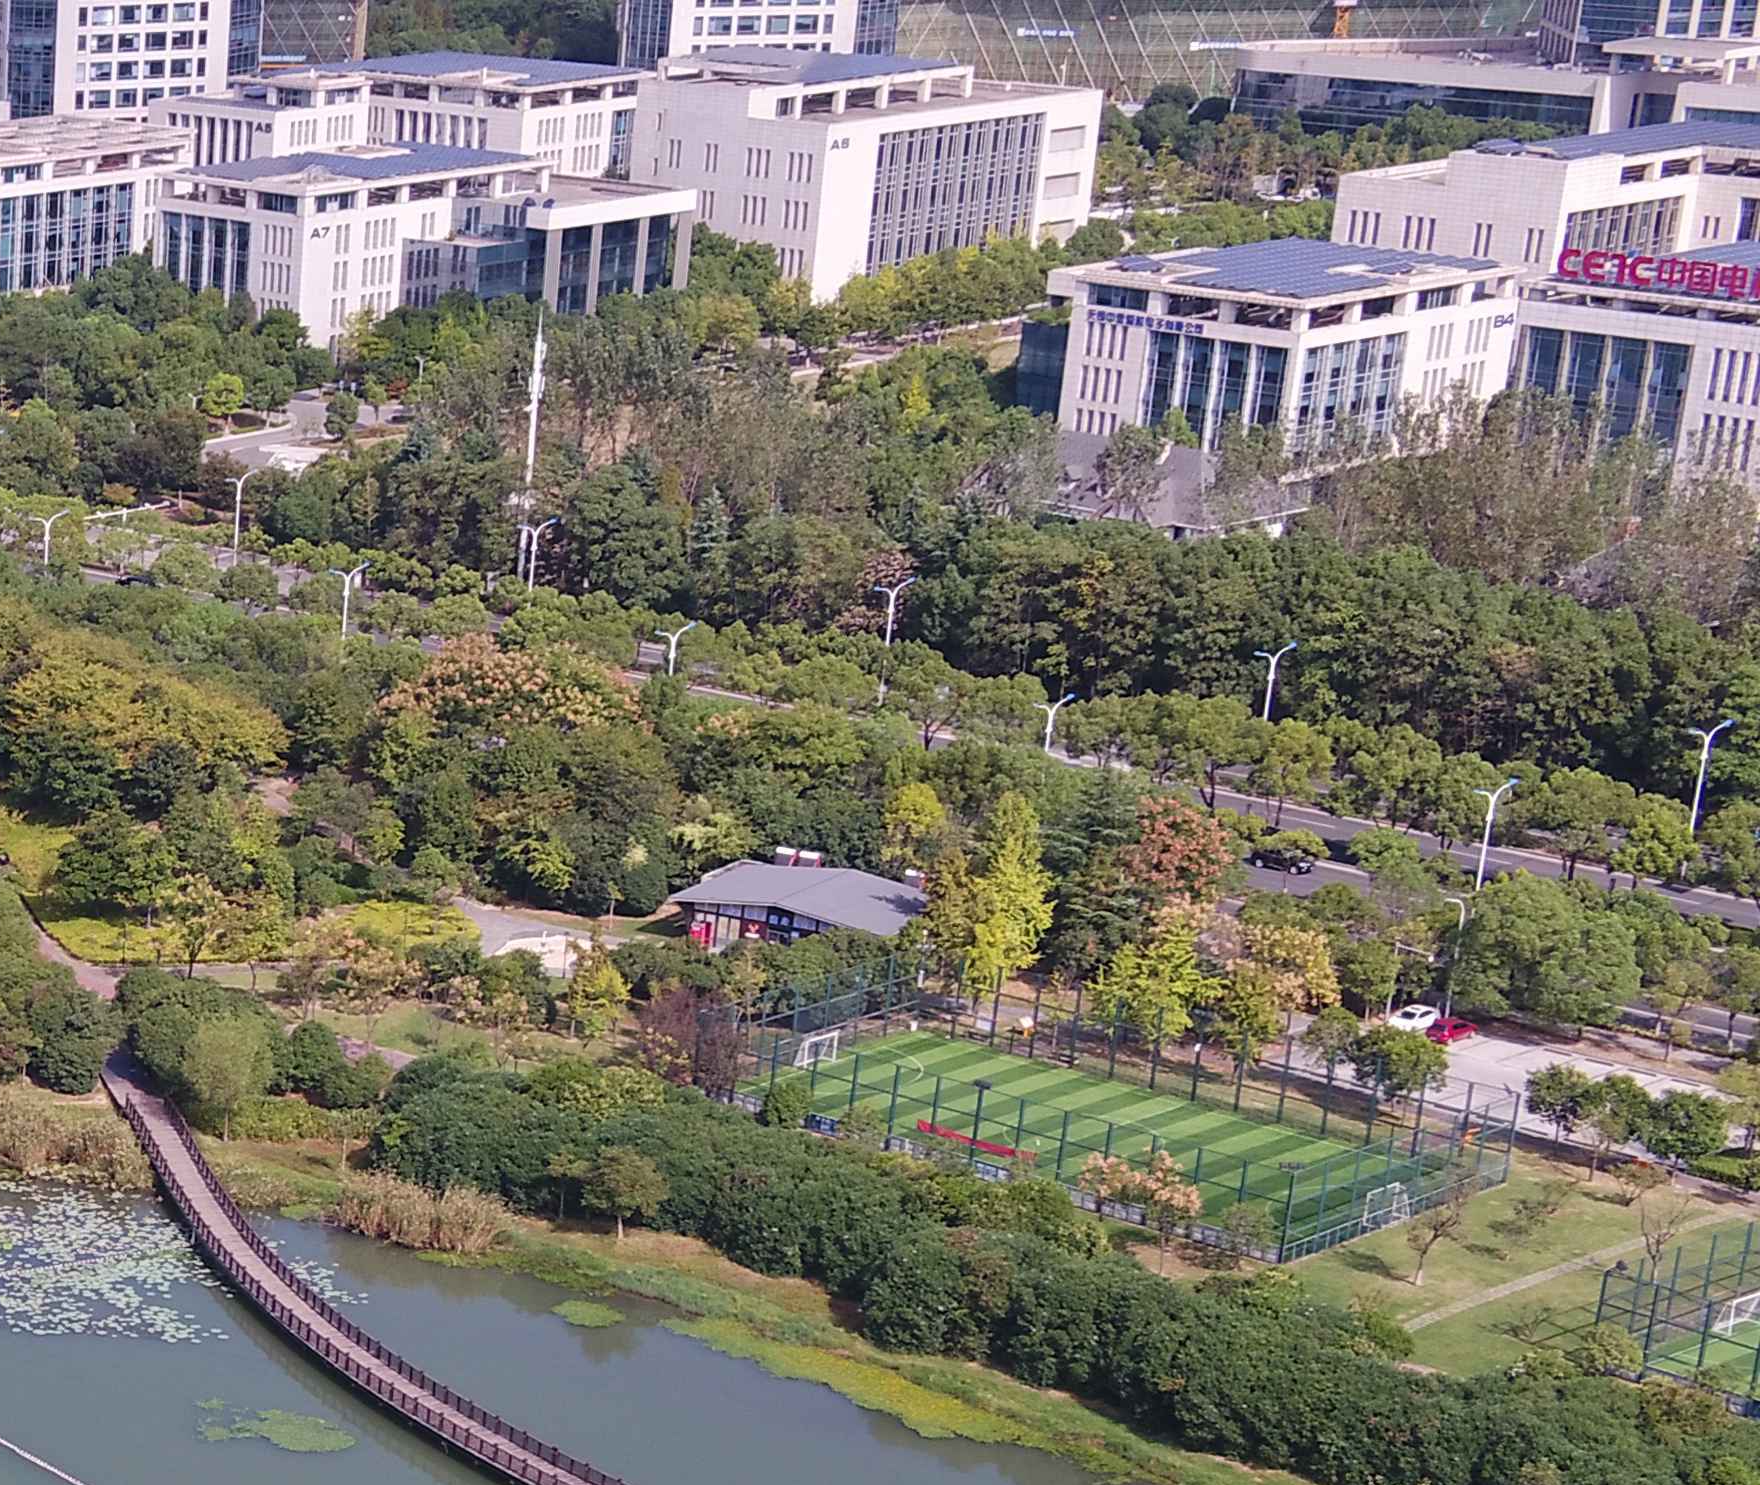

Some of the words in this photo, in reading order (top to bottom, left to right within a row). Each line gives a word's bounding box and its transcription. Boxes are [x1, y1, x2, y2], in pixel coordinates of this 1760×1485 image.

[310, 227, 330, 240] A7
[1557, 249, 1654, 286] CETC
[1493, 313, 1515, 328] B4
